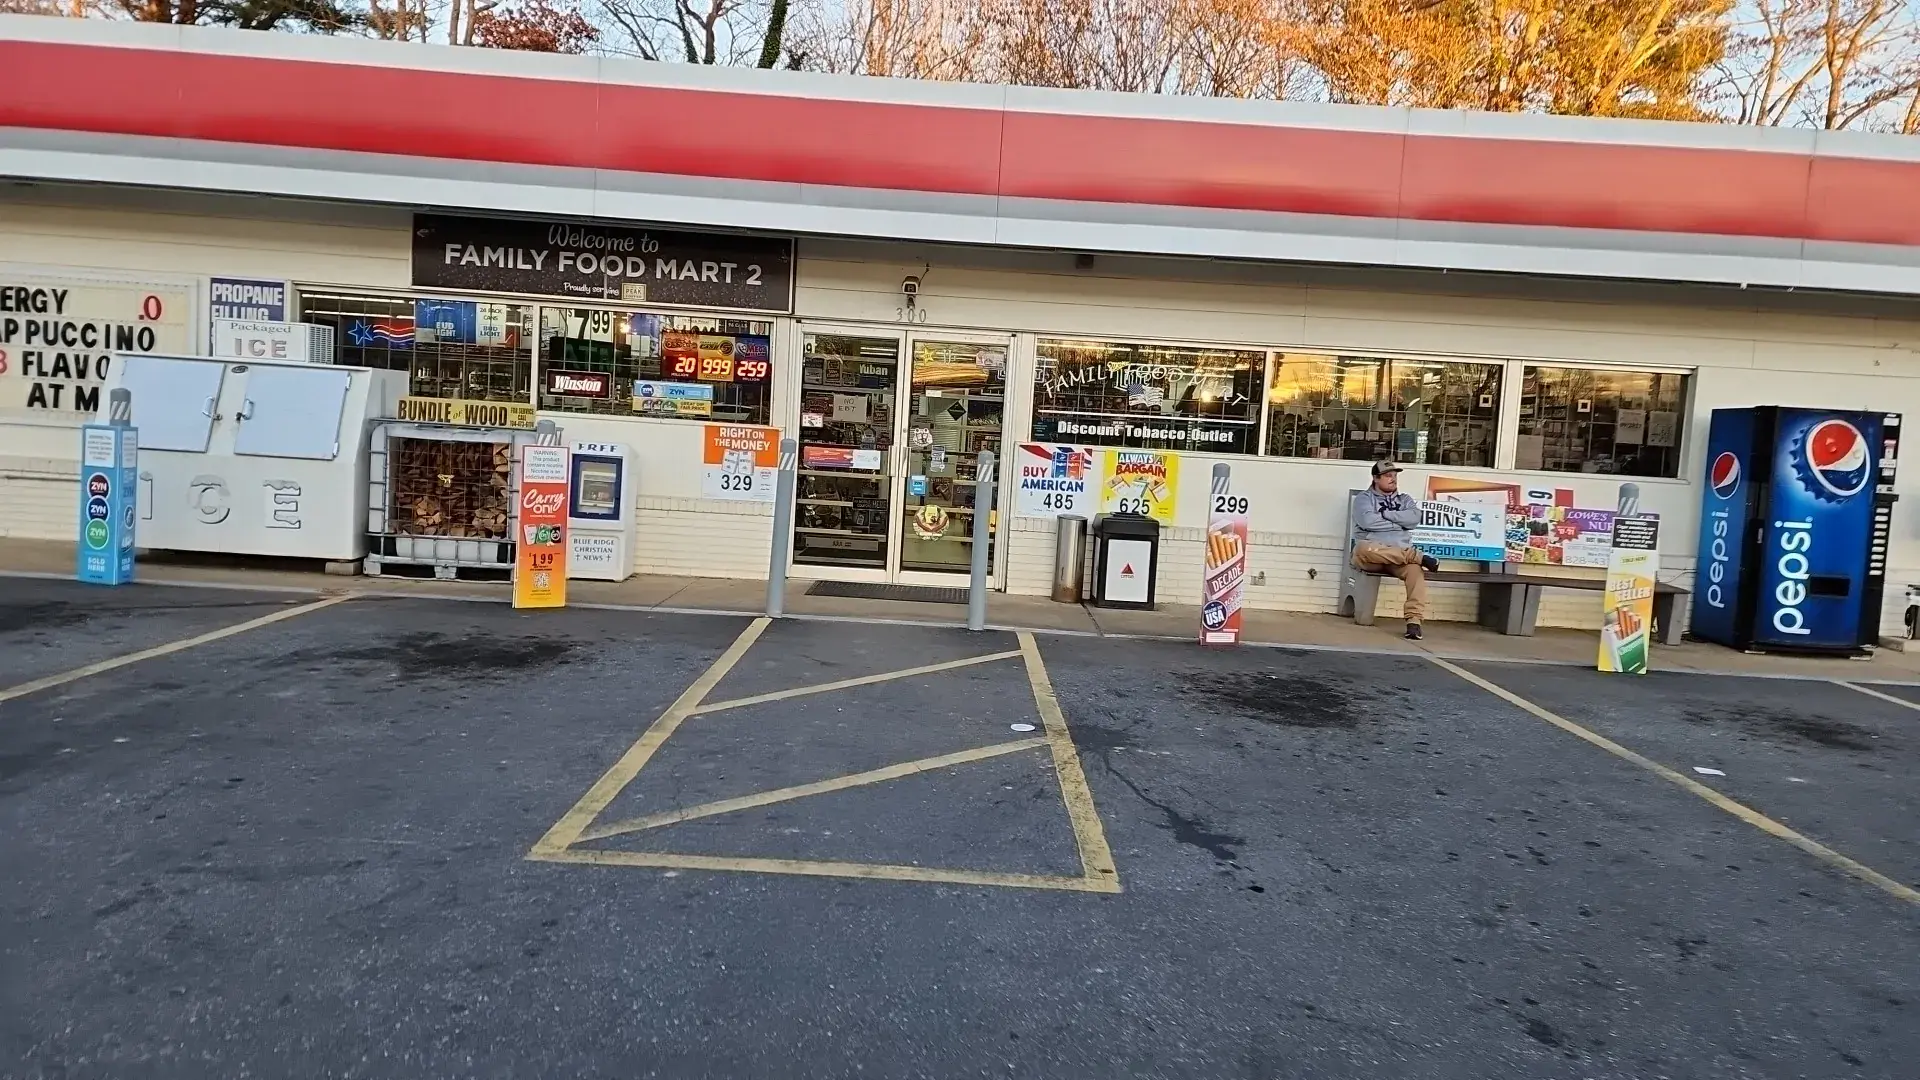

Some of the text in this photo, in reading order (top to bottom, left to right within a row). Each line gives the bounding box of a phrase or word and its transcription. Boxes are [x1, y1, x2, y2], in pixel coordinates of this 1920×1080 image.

[548, 224, 659, 253] Welcome to
[445, 243, 762, 286] FAMILY FOOD MART 2
[211, 282, 283, 306] PROPANE
[564, 282, 591, 294] Proudly
[0, 286, 68, 314] ERGY
[211, 304, 270, 321] FILLING
[896, 307, 927, 323] 300
[0, 318, 155, 352] PPUCCINO
[230, 322, 292, 337] Packaged
[234, 338, 288, 359] ICE
[675, 357, 697, 374] 20
[702, 359, 731, 375] 999
[738, 361, 767, 378] 259
[860, 363, 888, 376] Yuban
[555, 376, 602, 392] Winston
[1044, 362, 1115, 399] FAMILY
[27, 382, 64, 409] AT
[398, 400, 451, 423] BUNDLE
[465, 404, 508, 426] WOOD
[720, 427, 765, 439] RIGHT ON
[1057, 421, 1234, 443] Discount Tobacco Outlet
[578, 443, 618, 452] FREE
[714, 438, 771, 451] THE MONEY
[1118, 453, 1154, 465] ALWAYS
[1023, 466, 1048, 478] BUY
[1116, 464, 1167, 479] BARGAIN
[91, 481, 107, 492] ZYN
[721, 474, 752, 491] 329
[1021, 478, 1084, 492] AMERICAN
[139, 470, 301, 530] ICE
[523, 488, 566, 512] Carry
[1043, 493, 1074, 510] 485
[1119, 498, 1150, 515] 625
[1215, 495, 1249, 515] 299
[90, 504, 106, 515] ZYN
[1421, 502, 1467, 518] ROBBINS
[1567, 511, 1608, 522] LOWE'S
[1419, 509, 1466, 528] BING
[89, 527, 105, 538] ZYN
[1460, 548, 1479, 557] cell
[1707, 508, 1729, 608] pepsi
[1212, 562, 1243, 593] DECADE
[1773, 516, 1813, 635] pepsi
[1609, 578, 1636, 591] BEST
[1615, 588, 1652, 601] SELLER
[1206, 610, 1225, 626] USA
